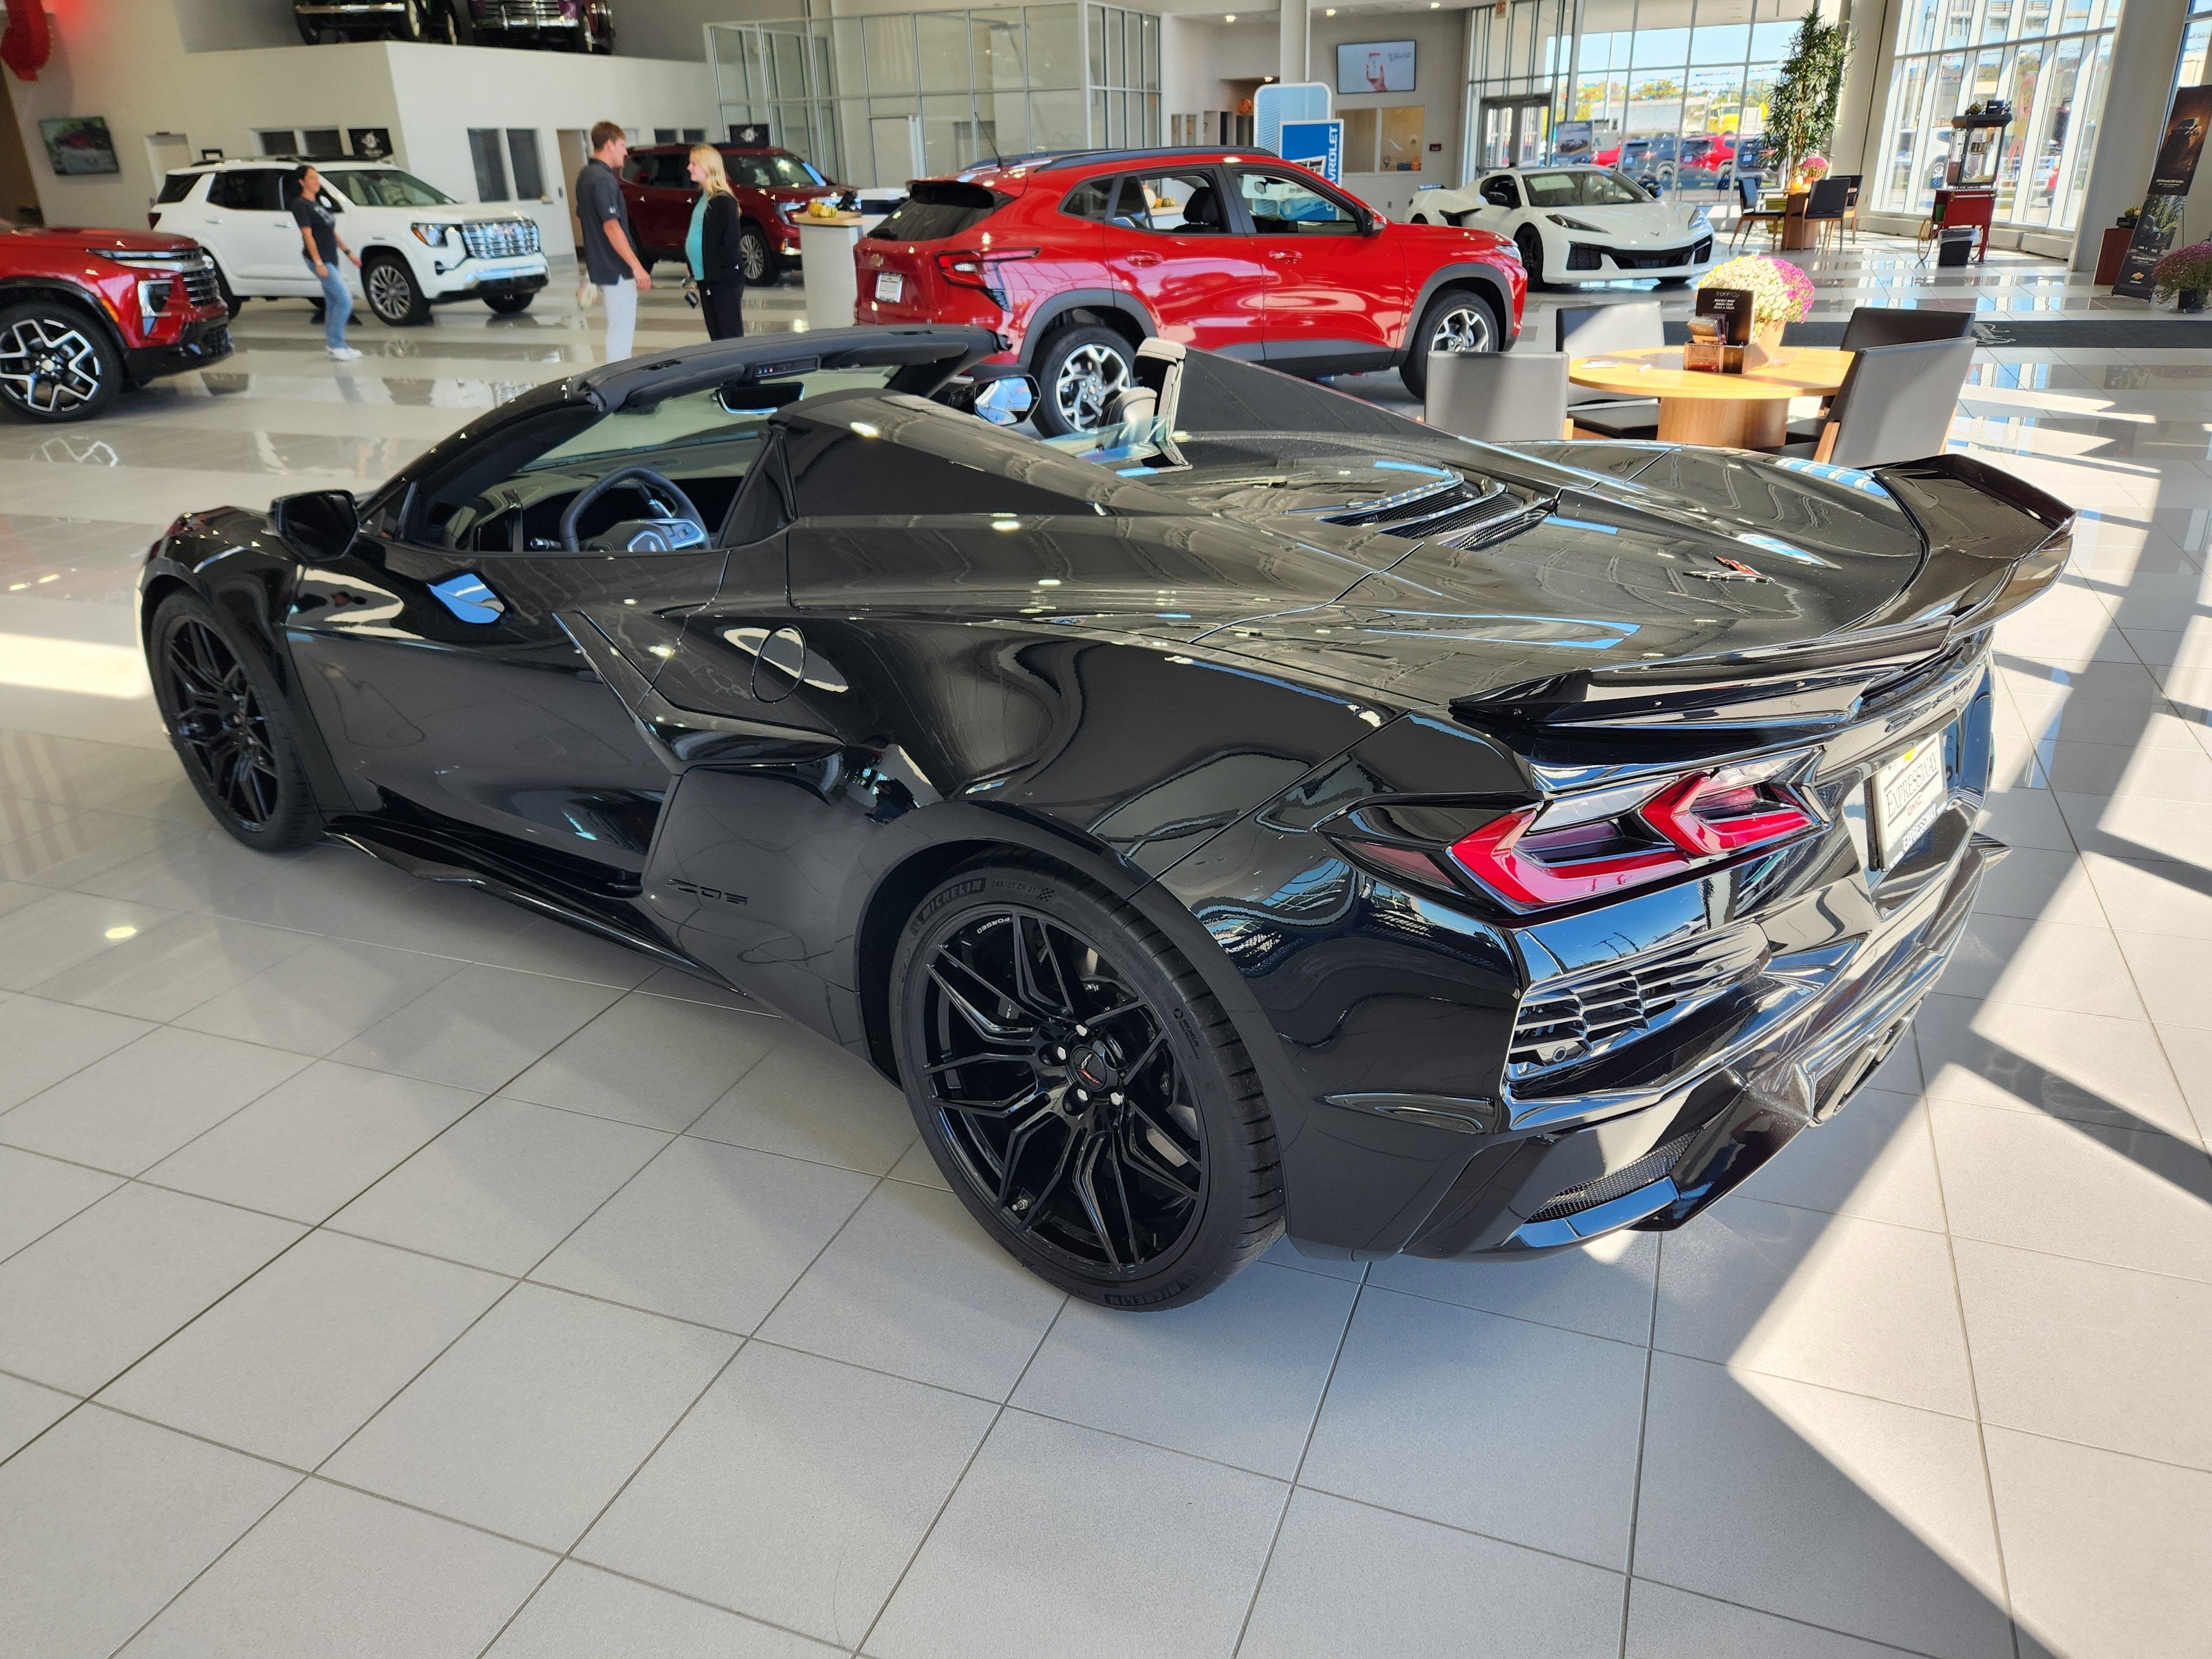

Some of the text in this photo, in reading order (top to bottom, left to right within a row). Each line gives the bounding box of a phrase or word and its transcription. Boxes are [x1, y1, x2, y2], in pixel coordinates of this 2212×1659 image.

[1326, 125, 1338, 212] CVROLET
[1886, 749, 1937, 818] EXPRESSWAY
[1907, 795, 1922, 816] GMC
[1902, 803, 1936, 853] EXPRESSWAY
[922, 879, 983, 919] MICHELIN
[1016, 883, 1026, 891] ZR
[977, 917, 1010, 934] FORGED
[1182, 1019, 1200, 1047] MICHELIN
[1109, 1283, 1181, 1306] MICHELIN
